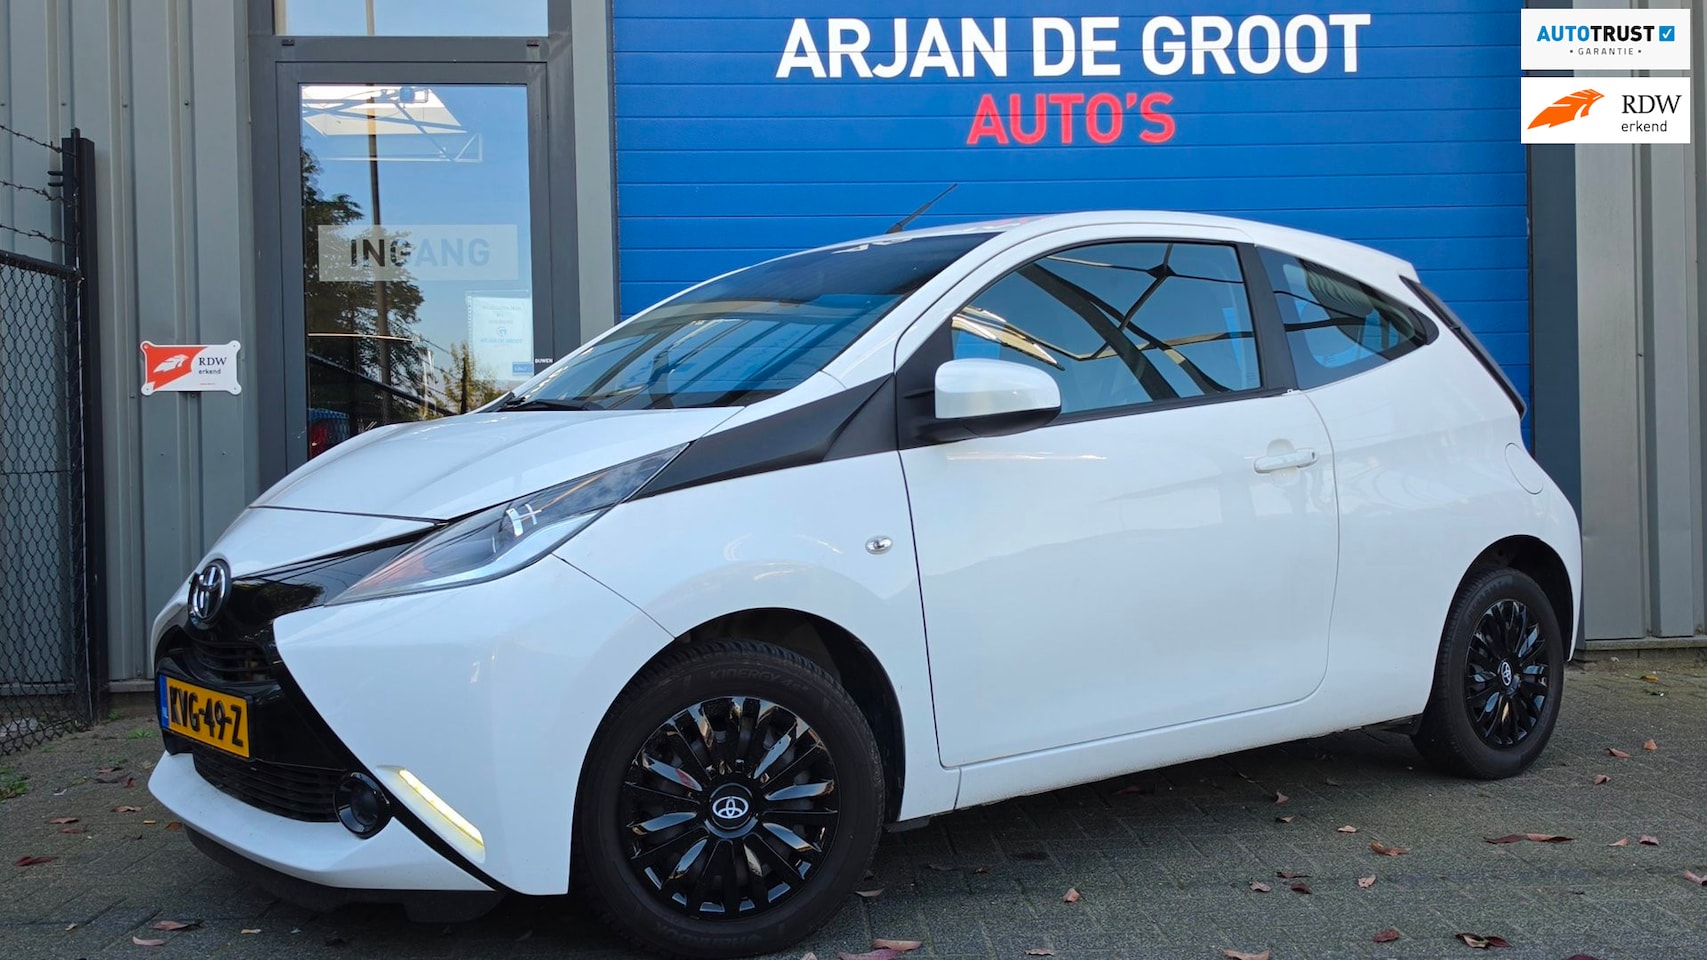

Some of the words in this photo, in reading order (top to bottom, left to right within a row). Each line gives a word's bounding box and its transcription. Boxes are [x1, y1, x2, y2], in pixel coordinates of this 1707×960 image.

[775, 17, 1007, 79] ARJAN
[1032, 16, 1121, 77] DE
[1141, 13, 1372, 77] GROOT
[966, 91, 1177, 145] AUTO'S
[350, 237, 491, 268] INGANG
[198, 356, 228, 367] RDW
